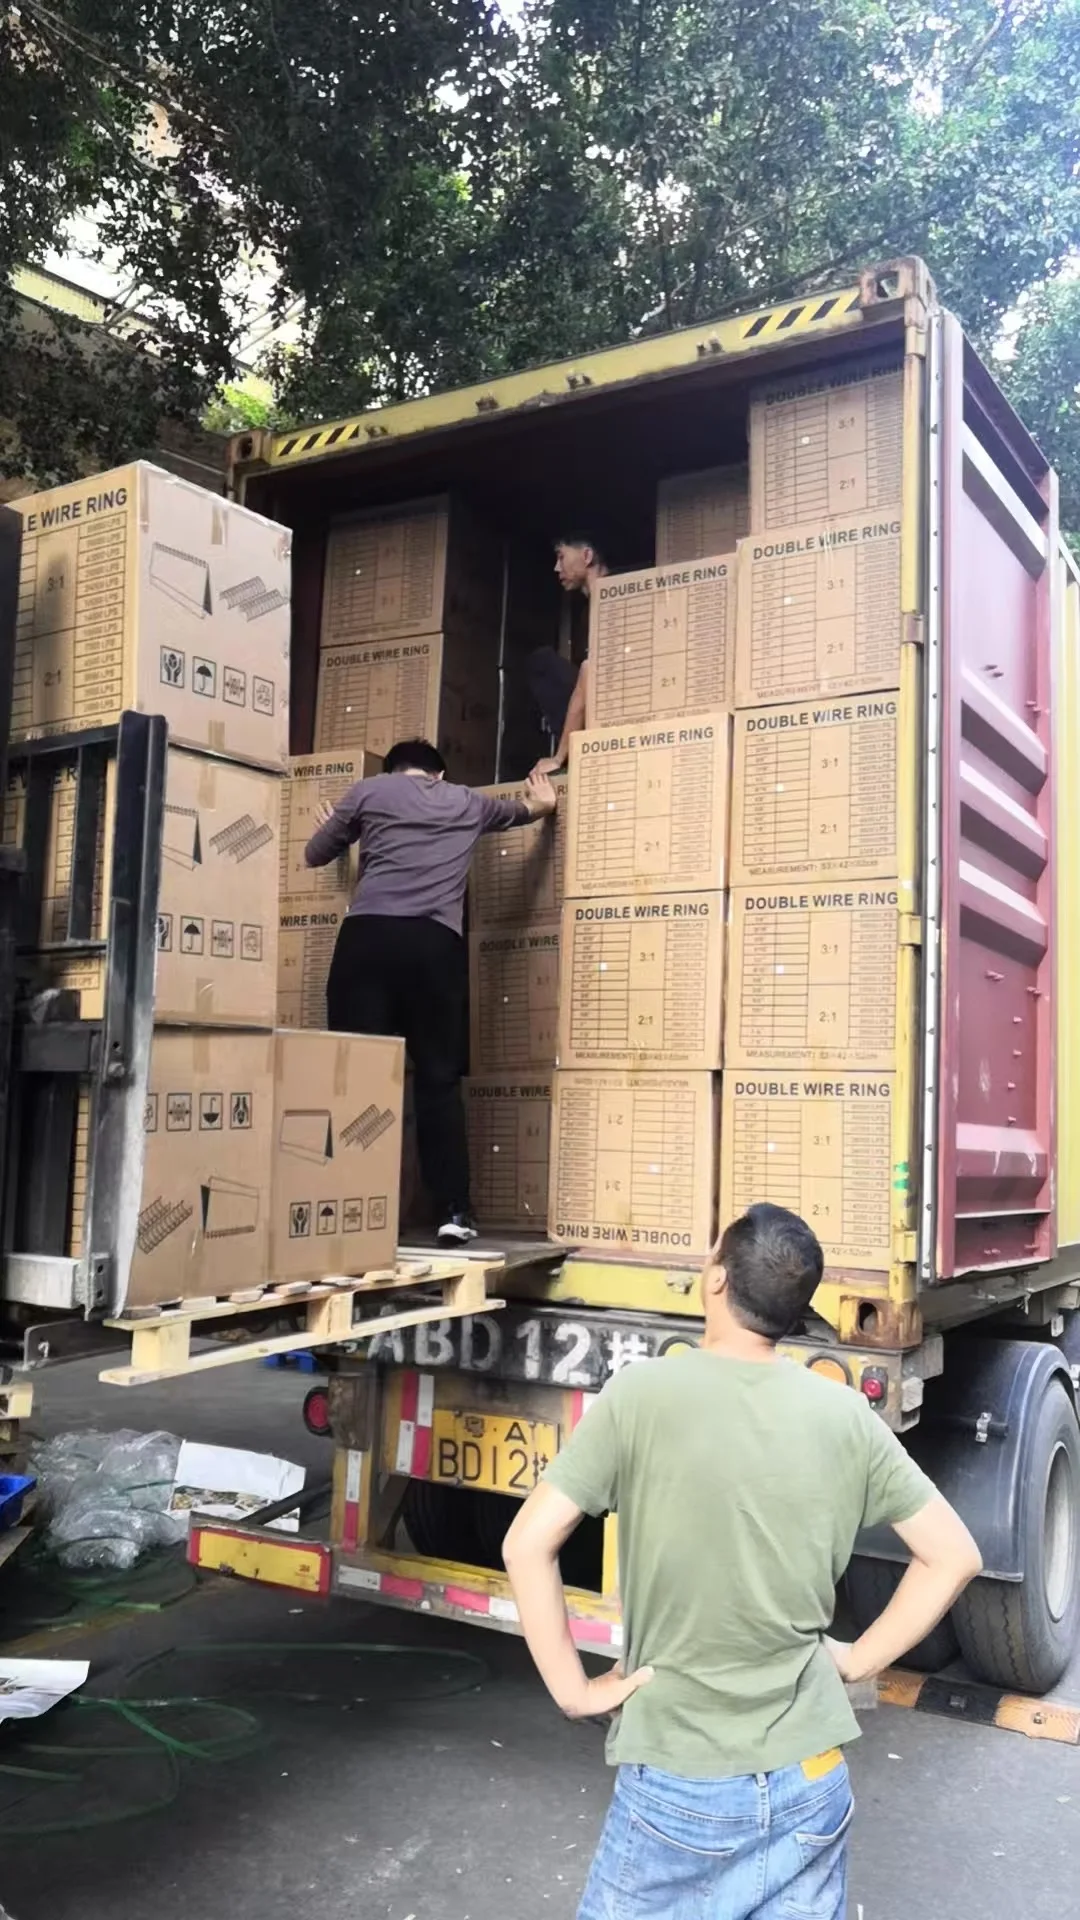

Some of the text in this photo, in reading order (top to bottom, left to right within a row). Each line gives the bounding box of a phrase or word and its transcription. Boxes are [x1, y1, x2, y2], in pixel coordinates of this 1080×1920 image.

[838, 478, 856, 490] 2:1
[41, 501, 82, 528] WIRE
[86, 488, 127, 515] RING
[753, 521, 900, 560] DOUBLE WIRE RING
[600, 564, 728, 600] DOUBLE WIRE RING
[326, 644, 430, 668] DOUBLE WIRE RING
[746, 702, 897, 732] DOUBLE WIRE RING
[581, 727, 714, 754] DOUBLE WIRE RING
[293, 762, 354, 777] WIRE RING
[820, 824, 838, 834] 2:1
[745, 892, 898, 910] DOUBLE WIRE RING
[575, 903, 709, 921] DOUBLE WIRE RING
[280, 913, 338, 927] WIRE RING
[529, 934, 559, 948] WIRE
[638, 1015, 654, 1025] 2:1
[819, 1012, 837, 1023] 2:1
[470, 1084, 549, 1098] DOUBLE WIRE
[735, 1082, 890, 1097] DOUBLE WIRE RING
[813, 1135, 831, 1146] 3:1
[812, 1205, 831, 1216] 2:1
[556, 1223, 692, 1247] DOUBLE WIRE RING
